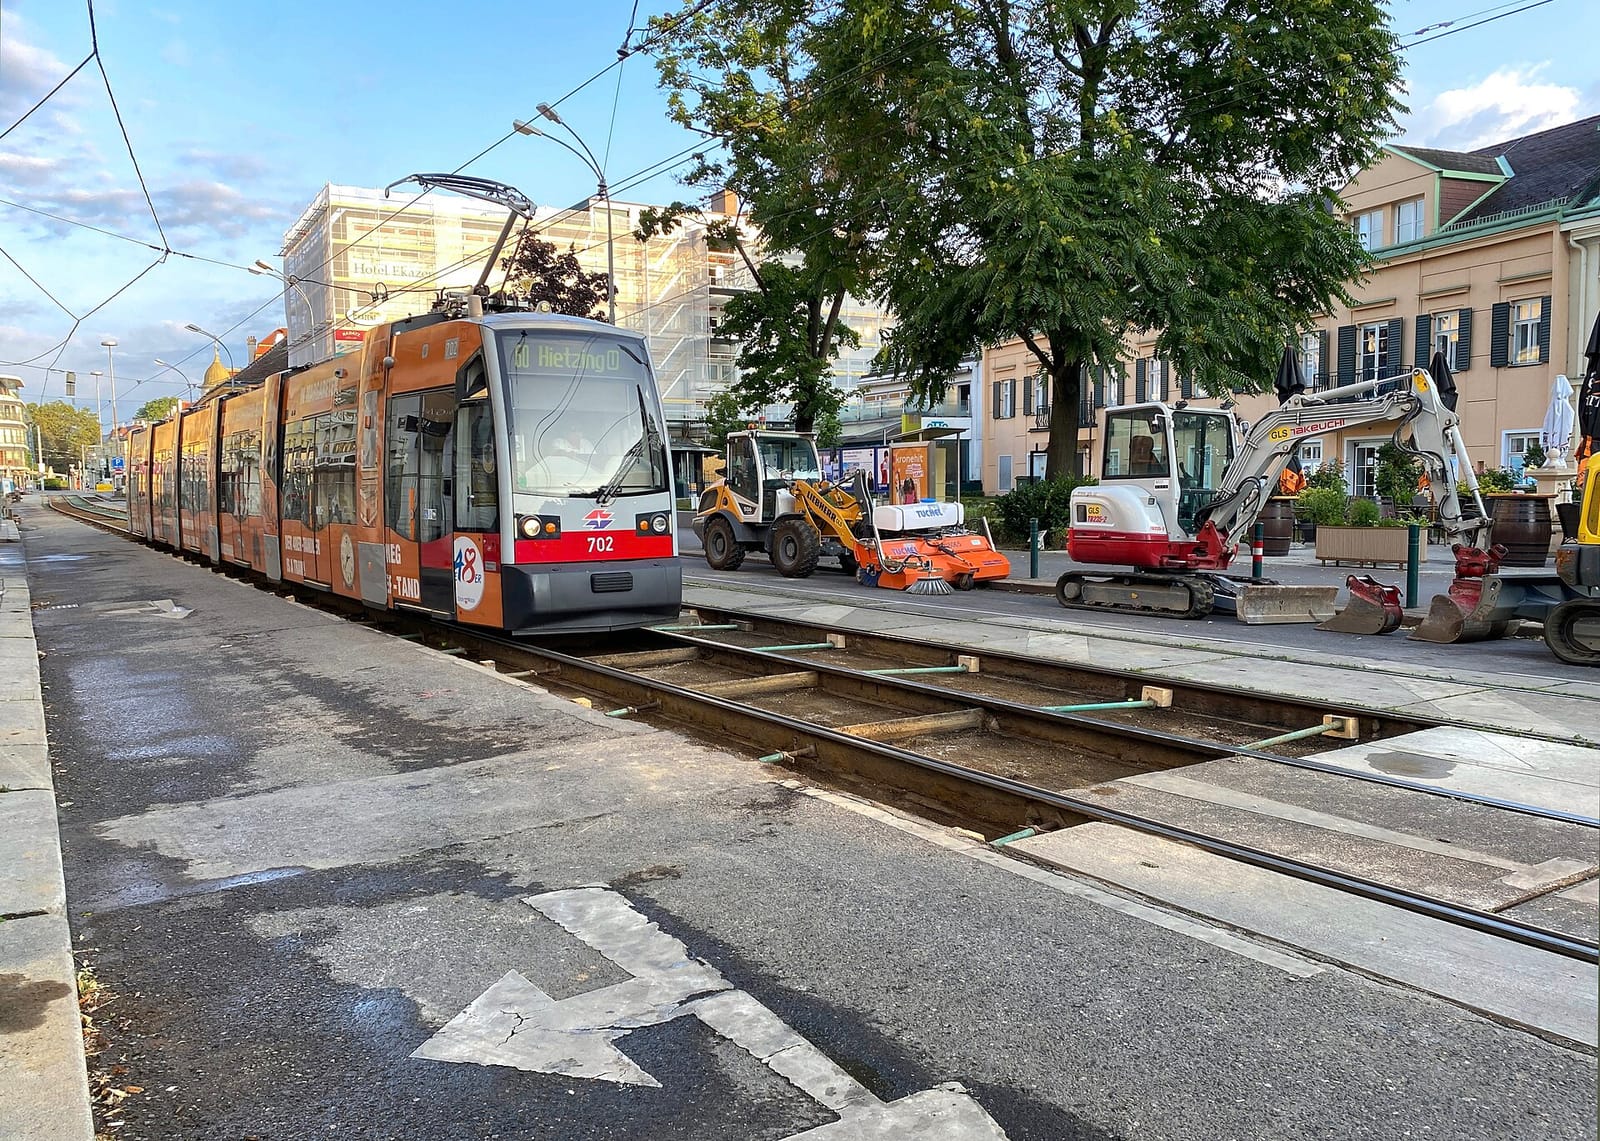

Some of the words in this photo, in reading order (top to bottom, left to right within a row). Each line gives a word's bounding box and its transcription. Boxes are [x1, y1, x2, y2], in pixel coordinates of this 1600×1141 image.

[353, 263, 389, 276] Hotel
[514, 343, 530, 368] 60
[537, 344, 605, 373] Hietzing
[1271, 429, 1288, 440] GLS
[895, 453, 924, 464] kronehit
[807, 491, 837, 523] LIEBHERR
[1087, 506, 1100, 515] GLS
[915, 508, 944, 519] TUCHEL
[586, 536, 614, 553] 702
